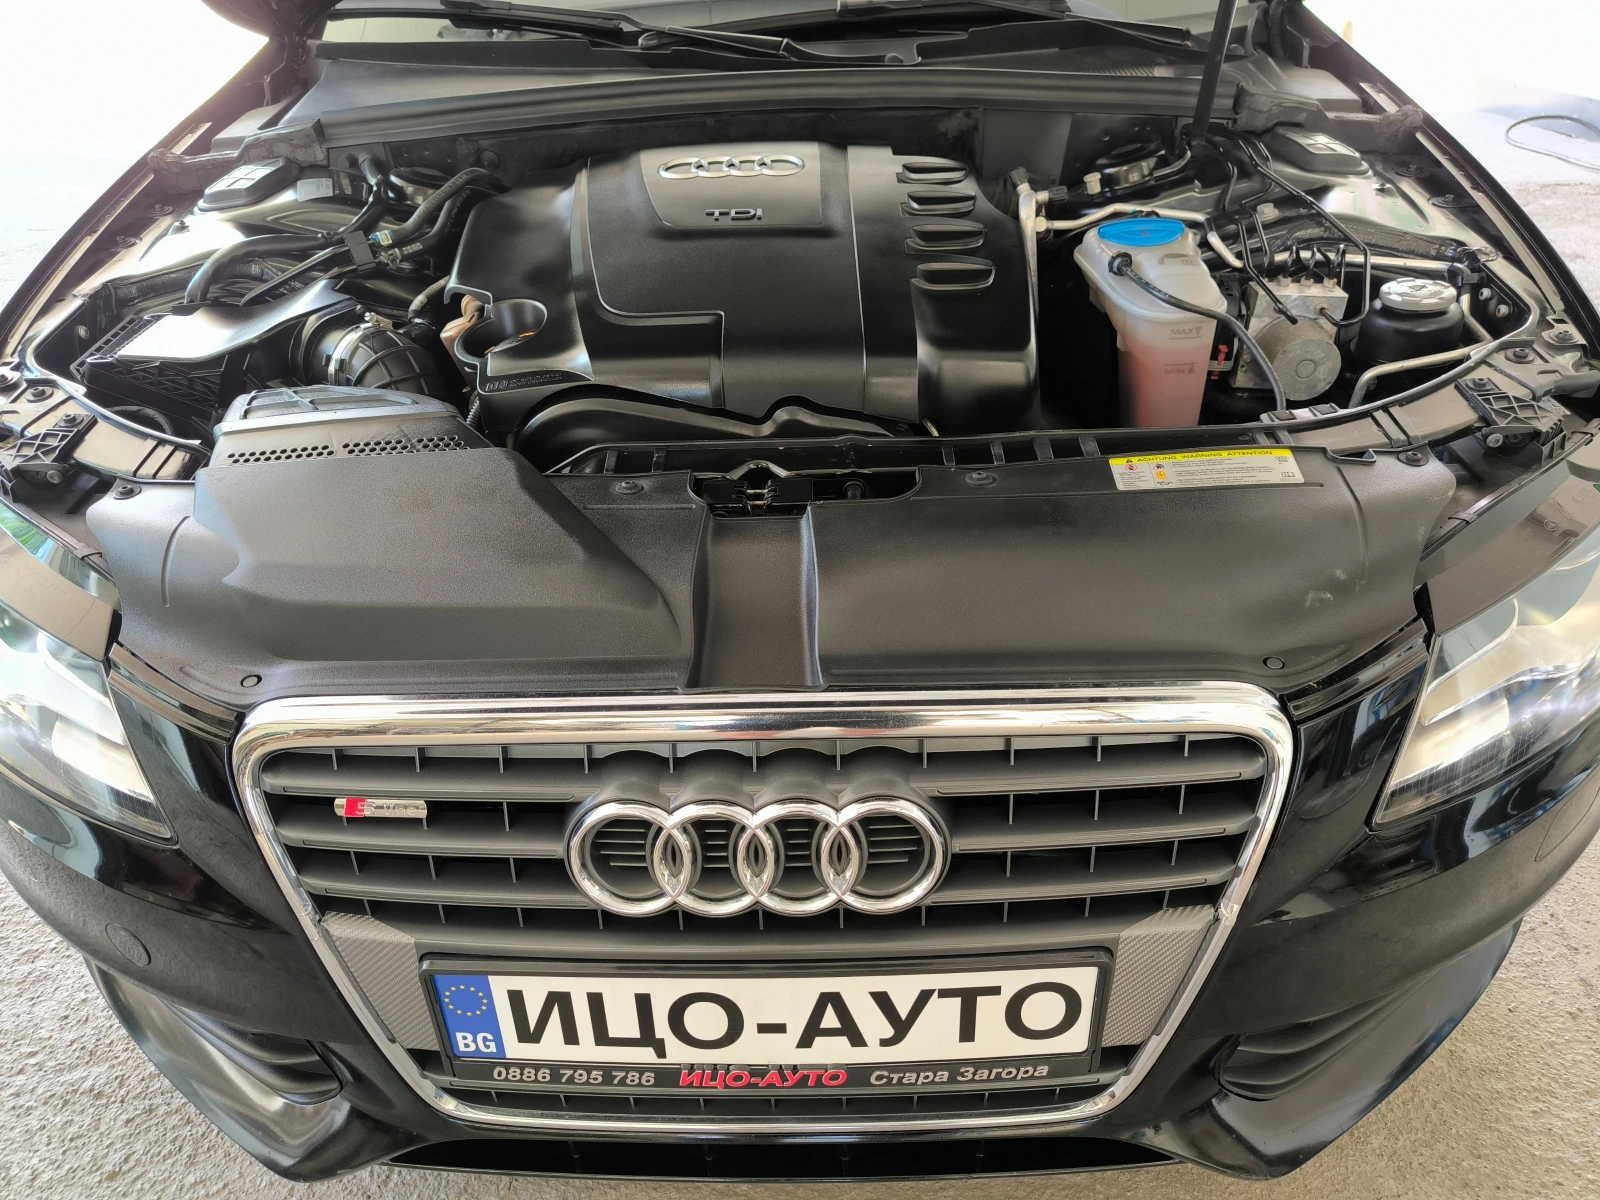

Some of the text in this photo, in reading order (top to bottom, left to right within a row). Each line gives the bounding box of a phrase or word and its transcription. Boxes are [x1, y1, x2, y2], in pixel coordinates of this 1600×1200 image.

[705, 208, 763, 221] TDI
[1170, 328, 1194, 336] MAX
[1181, 452, 1223, 460] WARNING
[1227, 450, 1273, 458] ATTENTION
[506, 981, 1082, 1059] ИЦО-АУТО
[455, 1032, 497, 1053] BG
[493, 1066, 656, 1086] 0886 795 786
[679, 1069, 847, 1089] ИЦО-АУТО
[869, 1065, 1049, 1086] Стара Загора
